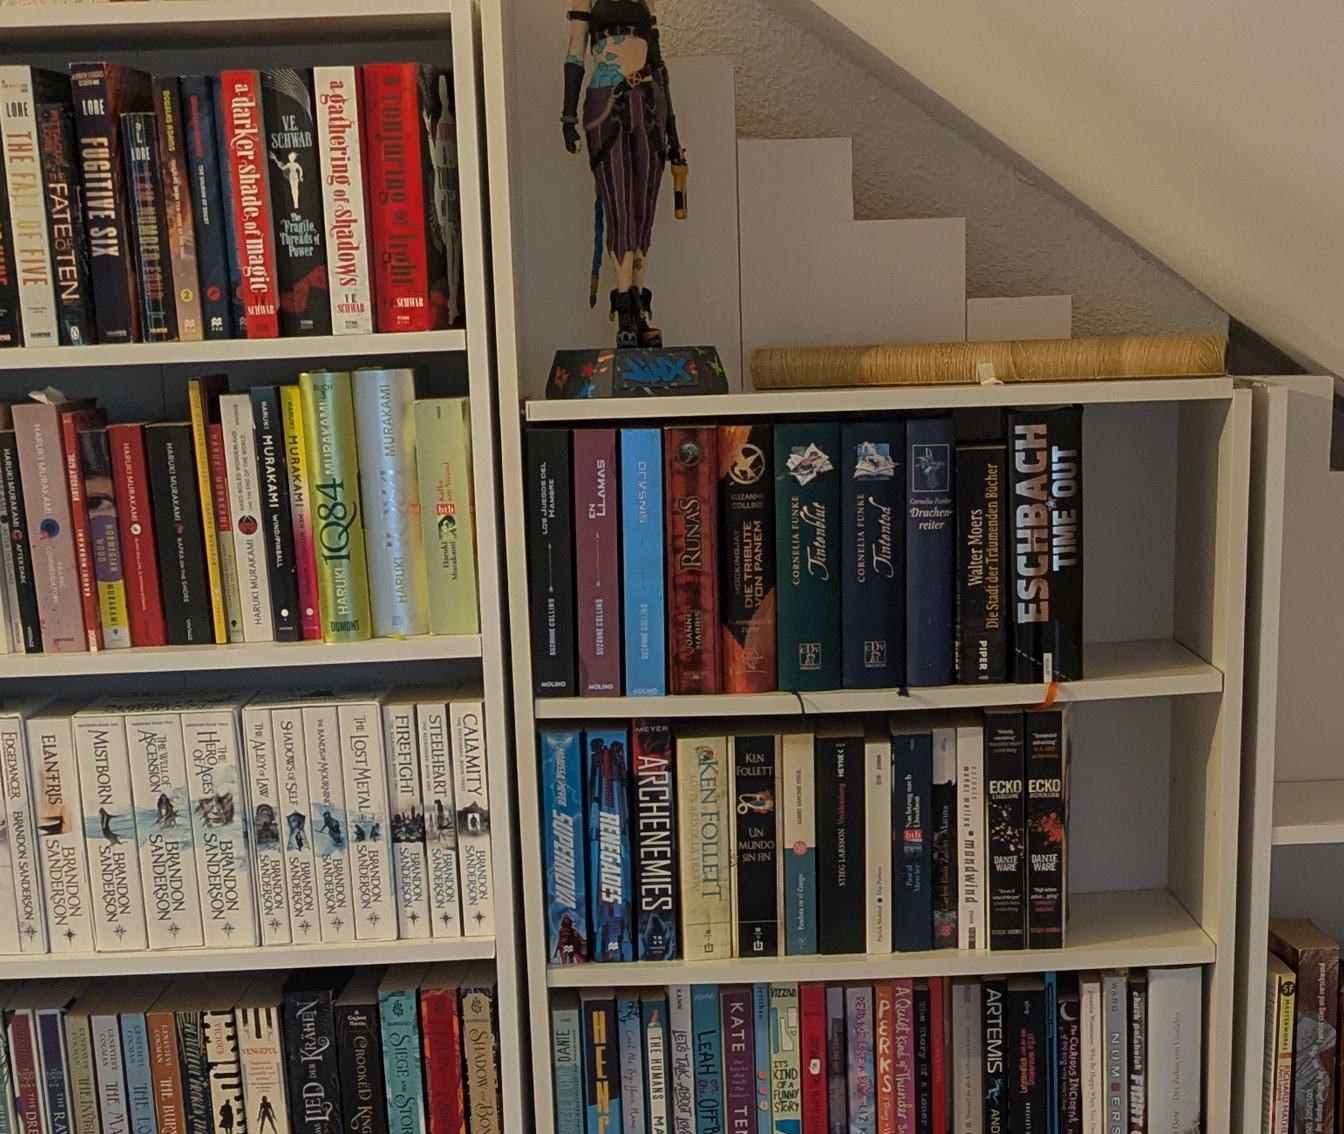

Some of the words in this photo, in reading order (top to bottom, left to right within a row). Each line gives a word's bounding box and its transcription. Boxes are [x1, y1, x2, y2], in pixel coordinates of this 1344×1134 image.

[82, 99, 104, 116] LORE
[234, 84, 249, 94] a
[232, 100, 256, 157] darker
[271, 131, 312, 148] SCHWAB
[319, 95, 352, 186] gathering
[81, 137, 117, 220] FUGITIVE
[233, 160, 261, 220] shade
[333, 189, 348, 206] of
[88, 227, 119, 257] SIX
[245, 220, 261, 237] of
[328, 207, 363, 287] shadows
[241, 234, 267, 292] magic
[260, 401, 270, 430] HARUKI
[319, 402, 335, 475] MURAKAMI
[262, 435, 280, 509] MURAKAMI
[596, 460, 606, 517] LLAMAS
[986, 464, 998, 499] Bücher
[1051, 446, 1077, 499] OUT
[316, 478, 358, 565] 1Q84
[588, 504, 596, 519] EN
[678, 496, 702, 572] RUNAS
[918, 521, 945, 530] reiter
[969, 509, 982, 546] Moers
[986, 501, 998, 559] Träumenden
[1014, 424, 1049, 624] ESCHBACH
[743, 521, 752, 579] TRIBUTE
[754, 520, 762, 574] PANEM
[1053, 510, 1077, 572] TIME
[336, 567, 349, 615] HARUKI
[755, 578, 764, 606] VON
[968, 549, 982, 587] Walter
[987, 561, 998, 577] der
[744, 582, 752, 609] DIE
[986, 579, 999, 609] Stadt
[986, 610, 999, 629] Die
[1, 731, 21, 800] EDGEDANCER
[40, 734, 62, 805] ELANTRIS
[88, 730, 113, 805] MISTBORN
[395, 715, 415, 796] FIREFIGHT
[429, 714, 448, 797] STEELHEART
[462, 713, 482, 796] CALAMITY
[698, 760, 717, 802] KEN
[990, 780, 1022, 794] ECKO
[1029, 779, 1060, 793] ECKO
[12, 811, 26, 860] BRANDON
[599, 811, 623, 905] RENEGADES
[638, 756, 672, 911] ARCHENEMIES
[700, 810, 721, 901] FOLLETT
[1032, 854, 1058, 863] DANTE
[45, 839, 68, 926] SANDERSON
[60, 846, 82, 918] BRANDON
[552, 810, 576, 910] SUPERNOVA
[994, 855, 1017, 864] DANTE
[995, 862, 1017, 872] WARE
[1033, 862, 1057, 871] WARE
[17, 861, 34, 920] SANDERSON
[649, 1035, 660, 1051] THE
[730, 1002, 745, 1052] KATE
[878, 1000, 892, 1093] PERKS
[985, 988, 1003, 1074] ARTEMIS
[352, 1035, 371, 1102] CROOKED
[650, 1053, 663, 1101] HUMANS
[773, 1069, 798, 1080] KIND
[304, 1082, 330, 1122] LIED
[773, 1090, 799, 1101] FUNNY
[774, 1102, 799, 1113] STORY
